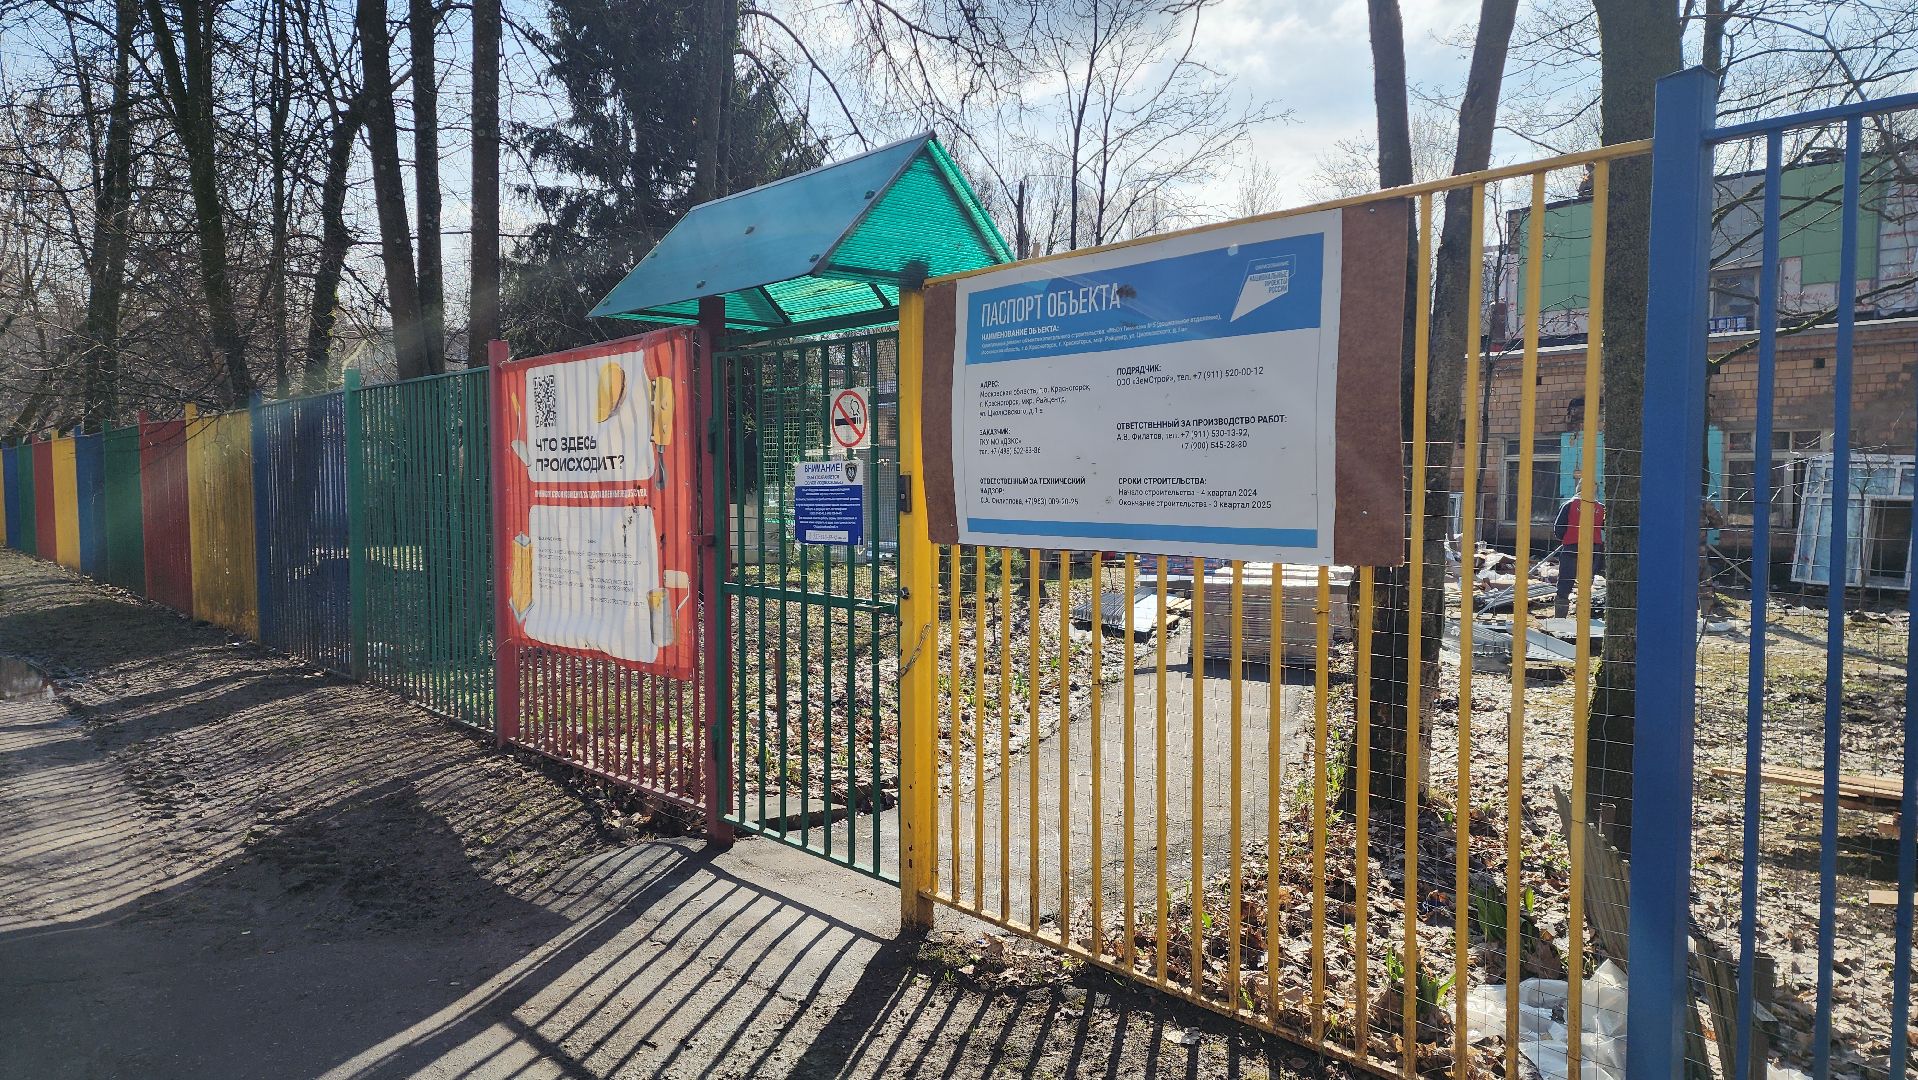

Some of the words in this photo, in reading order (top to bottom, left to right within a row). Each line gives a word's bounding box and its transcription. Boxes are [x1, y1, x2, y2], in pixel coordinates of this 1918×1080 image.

[981, 294, 1044, 328] ПАСПОРТ
[1047, 282, 1121, 318] ОБЪЕКТА
[981, 327, 1028, 341] НАИМЕНОВАНИЕ
[1117, 364, 1162, 376] ПОДРЯДЧИК:
[1116, 377, 1131, 387] ООО
[1132, 375, 1176, 386] «ЗемСтрой»,
[1177, 373, 1192, 382] тел.
[1203, 369, 1223, 381] (911)
[1225, 366, 1264, 378] 520-00-12
[980, 380, 1000, 388] АДРЕС:
[1116, 418, 1180, 430] ОТВЕТСТВЕННЫЙ
[1192, 416, 1256, 427] ПРОИЗВОДСТВО
[1257, 414, 1288, 424] РАБОТ:
[979, 427, 1011, 436] ЗАКАЗЧИК:
[1131, 432, 1164, 441] Филатов,
[1191, 429, 1210, 440] (911)
[1211, 428, 1250, 438] 530-13-92,
[536, 437, 558, 452] ЧТО
[560, 435, 597, 453] ЗДЕСЬ
[535, 454, 625, 474] ПРОИСХОДИТ?
[804, 462, 843, 473] ВНИМАНИЕ!
[979, 476, 1029, 485] ОТВЕТСТВЕННЫЙ
[1029, 477, 1038, 485] ЗА
[1039, 475, 1086, 485] ТЕХНИЧЕСКИЙ
[1118, 477, 1142, 485] СРОКИ
[1143, 477, 1207, 485] СТРОИТЕЛЬСТВА:
[1118, 488, 1144, 496] Начало
[1144, 488, 1195, 498] строительства
[1207, 488, 1237, 498] квартал
[1238, 488, 1258, 497] 2024
[1118, 498, 1156, 507] Окончание
[1156, 500, 1208, 509] строительства
[1219, 501, 1250, 510] квартал
[1251, 500, 1272, 509] 2025
